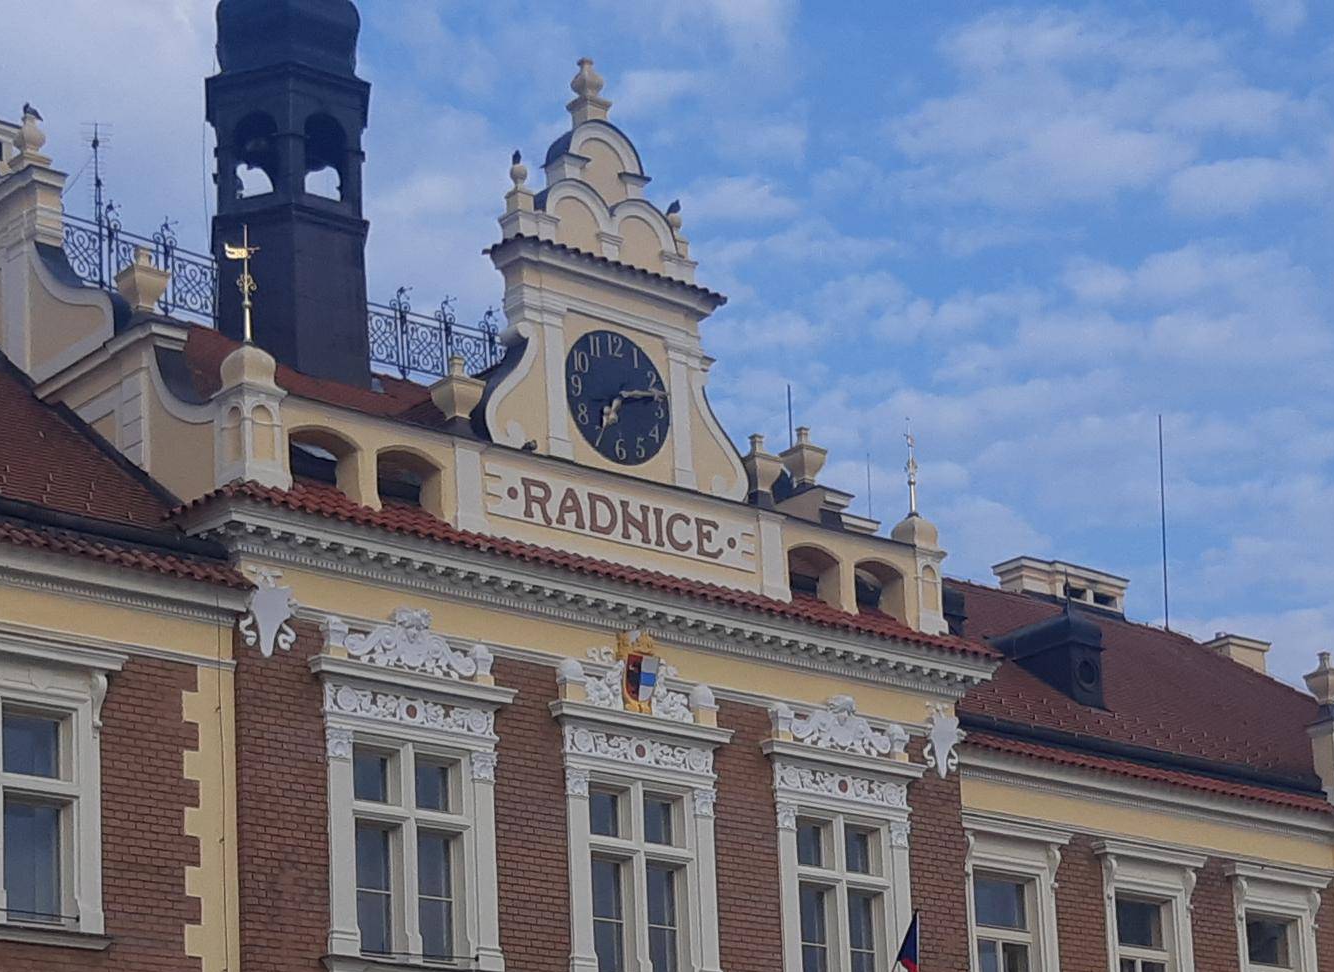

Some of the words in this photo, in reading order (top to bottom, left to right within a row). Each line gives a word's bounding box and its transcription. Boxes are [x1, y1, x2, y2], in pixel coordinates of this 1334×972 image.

[589, 335, 600, 357] 11
[607, 334, 623, 358] 12
[573, 350, 589, 373] 10
[633, 348, 639, 368] 1
[571, 374, 582, 396] 9
[647, 371, 657, 391] 2
[578, 402, 588, 425] 8
[648, 424, 659, 443] 4
[616, 439, 626, 460] 6
[636, 437, 645, 458] 5
[521, 477, 723, 558] RADNICE
